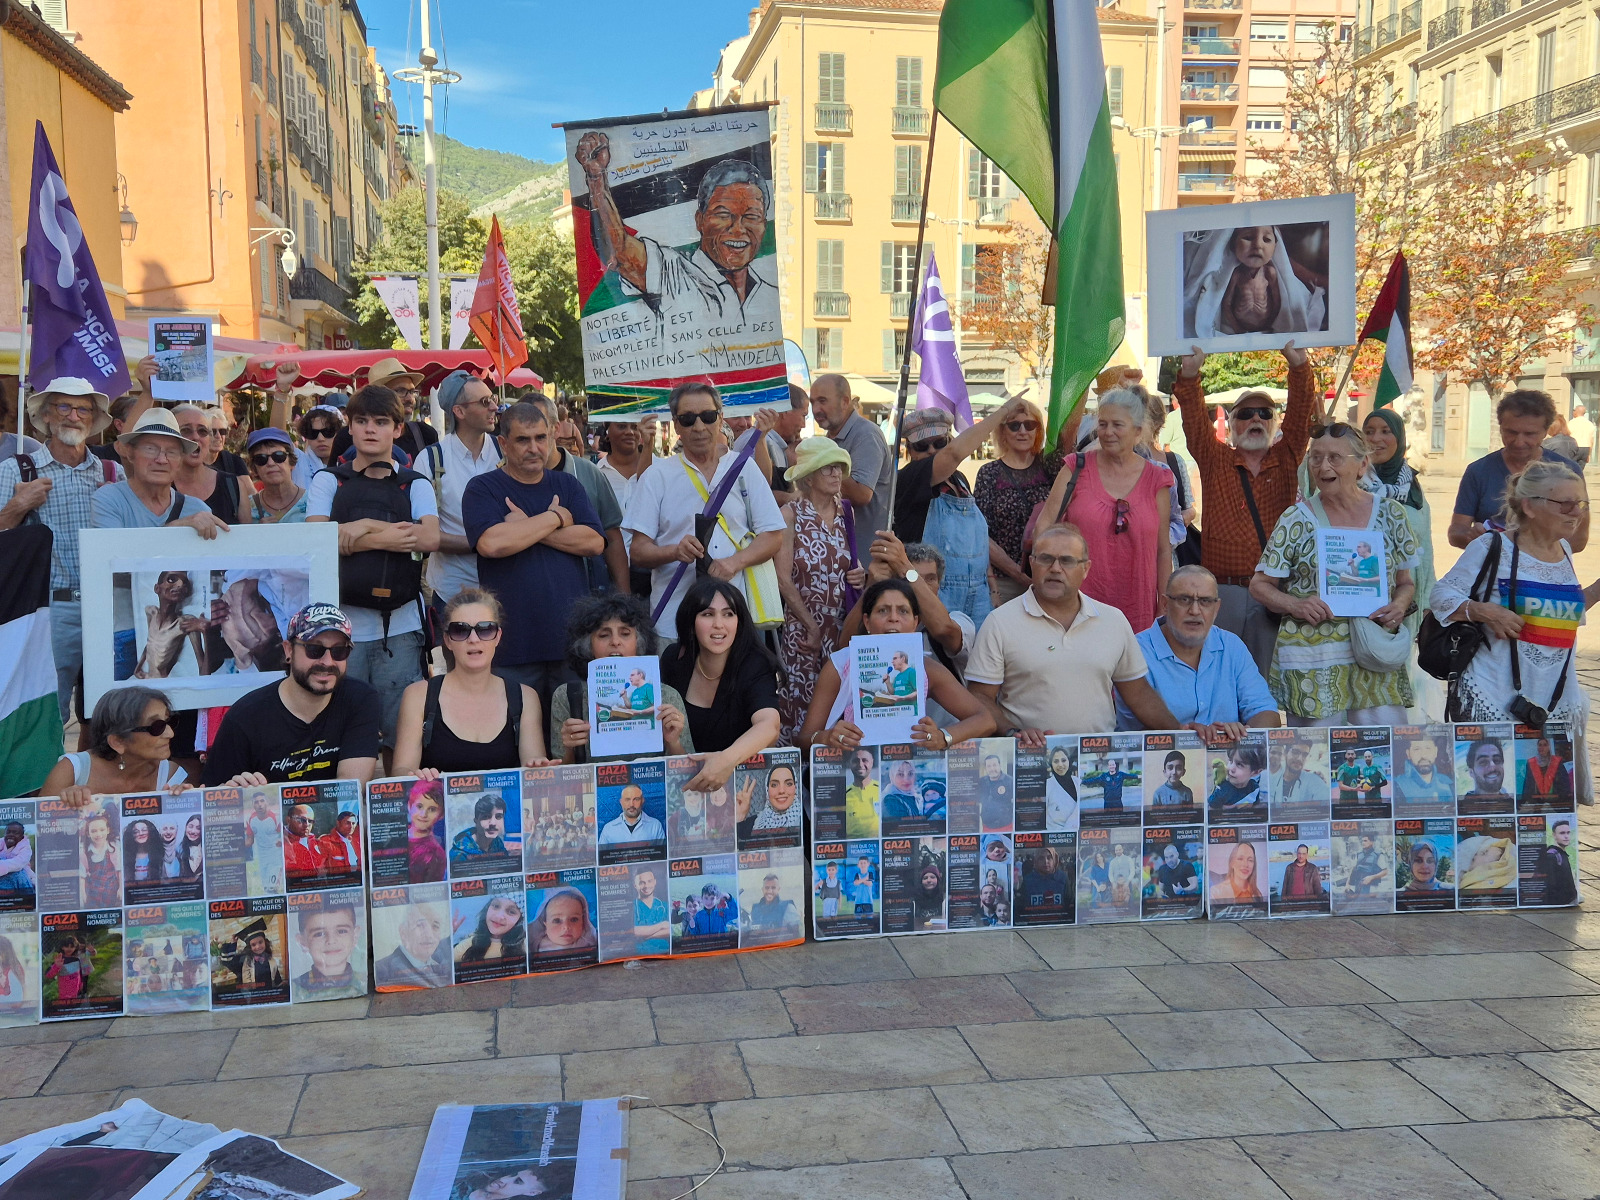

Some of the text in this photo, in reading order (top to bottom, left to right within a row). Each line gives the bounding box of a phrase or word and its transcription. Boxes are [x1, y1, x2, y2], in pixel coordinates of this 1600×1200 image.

[633, 120, 758, 140] حريتنا ناقصة بدون حرية
[634, 141, 688, 158] الفلسطينيين
[586, 311, 629, 330] NOTRE
[600, 311, 694, 343] LIBERTÉ EST
[336, 340, 350, 348] BIO
[589, 322, 774, 362] INCOMPLÈTE SANS CELLE DES
[1525, 597, 1578, 620] PAIX
[1270, 730, 1294, 738] GAZA
[1083, 738, 1108, 746] GAZA
[1147, 736, 1172, 744] GAZA
[816, 748, 842, 756] GAZA
[884, 746, 910, 754] GAZA
[669, 759, 697, 768] GAZA
[598, 765, 627, 775] GAZA
[525, 770, 554, 780] GAZA
[598, 775, 628, 784] FACES
[451, 776, 480, 787] GAZA
[284, 787, 316, 798] GAZA
[371, 783, 403, 794] GAZA
[206, 789, 239, 801] GAZA
[125, 798, 158, 810] GAZA
[1396, 821, 1421, 829] GAZA
[1520, 817, 1543, 825] GAZA
[1332, 822, 1357, 830] GAZA
[1081, 830, 1107, 839] GAZA
[1146, 829, 1170, 838] GAZA
[1210, 829, 1235, 837] GAZA
[951, 837, 977, 846] GAZA
[1016, 834, 1042, 842] GAZA
[817, 844, 843, 853] GAZA
[885, 840, 910, 849] GAZA
[739, 853, 766, 862] GAZA
[672, 861, 699, 870] GAZA
[600, 866, 628, 876] GAZA
[526, 873, 556, 882] GAZA
[452, 880, 483, 891] GAZA
[373, 888, 405, 900] GAZA
[289, 894, 322, 904] GAZA
[211, 900, 244, 911] GAZA
[128, 907, 162, 918] GAZA
[44, 914, 78, 926] GAZA
